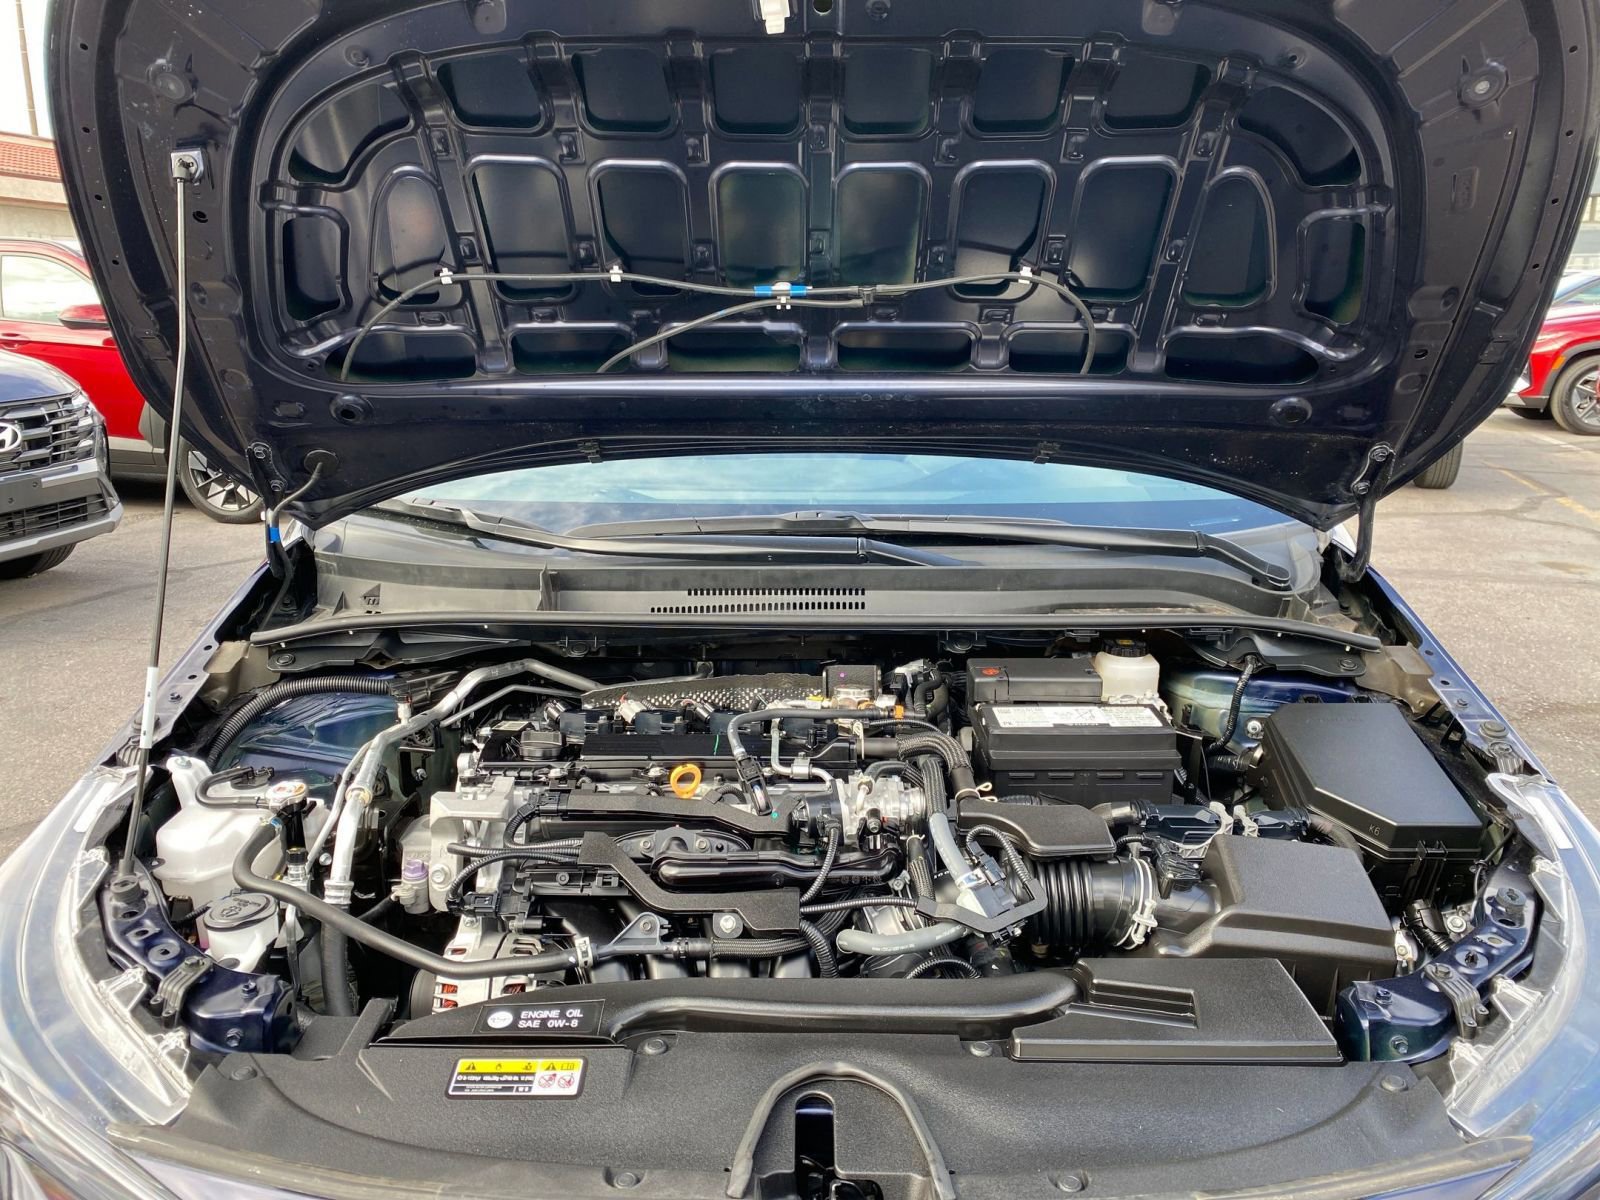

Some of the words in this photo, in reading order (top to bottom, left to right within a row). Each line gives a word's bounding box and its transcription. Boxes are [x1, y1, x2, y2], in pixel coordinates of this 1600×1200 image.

[1369, 823, 1381, 836] K6
[520, 1010, 560, 1019] ENGINE
[566, 1009, 583, 1018] OIL
[518, 1020, 541, 1028] SAE
